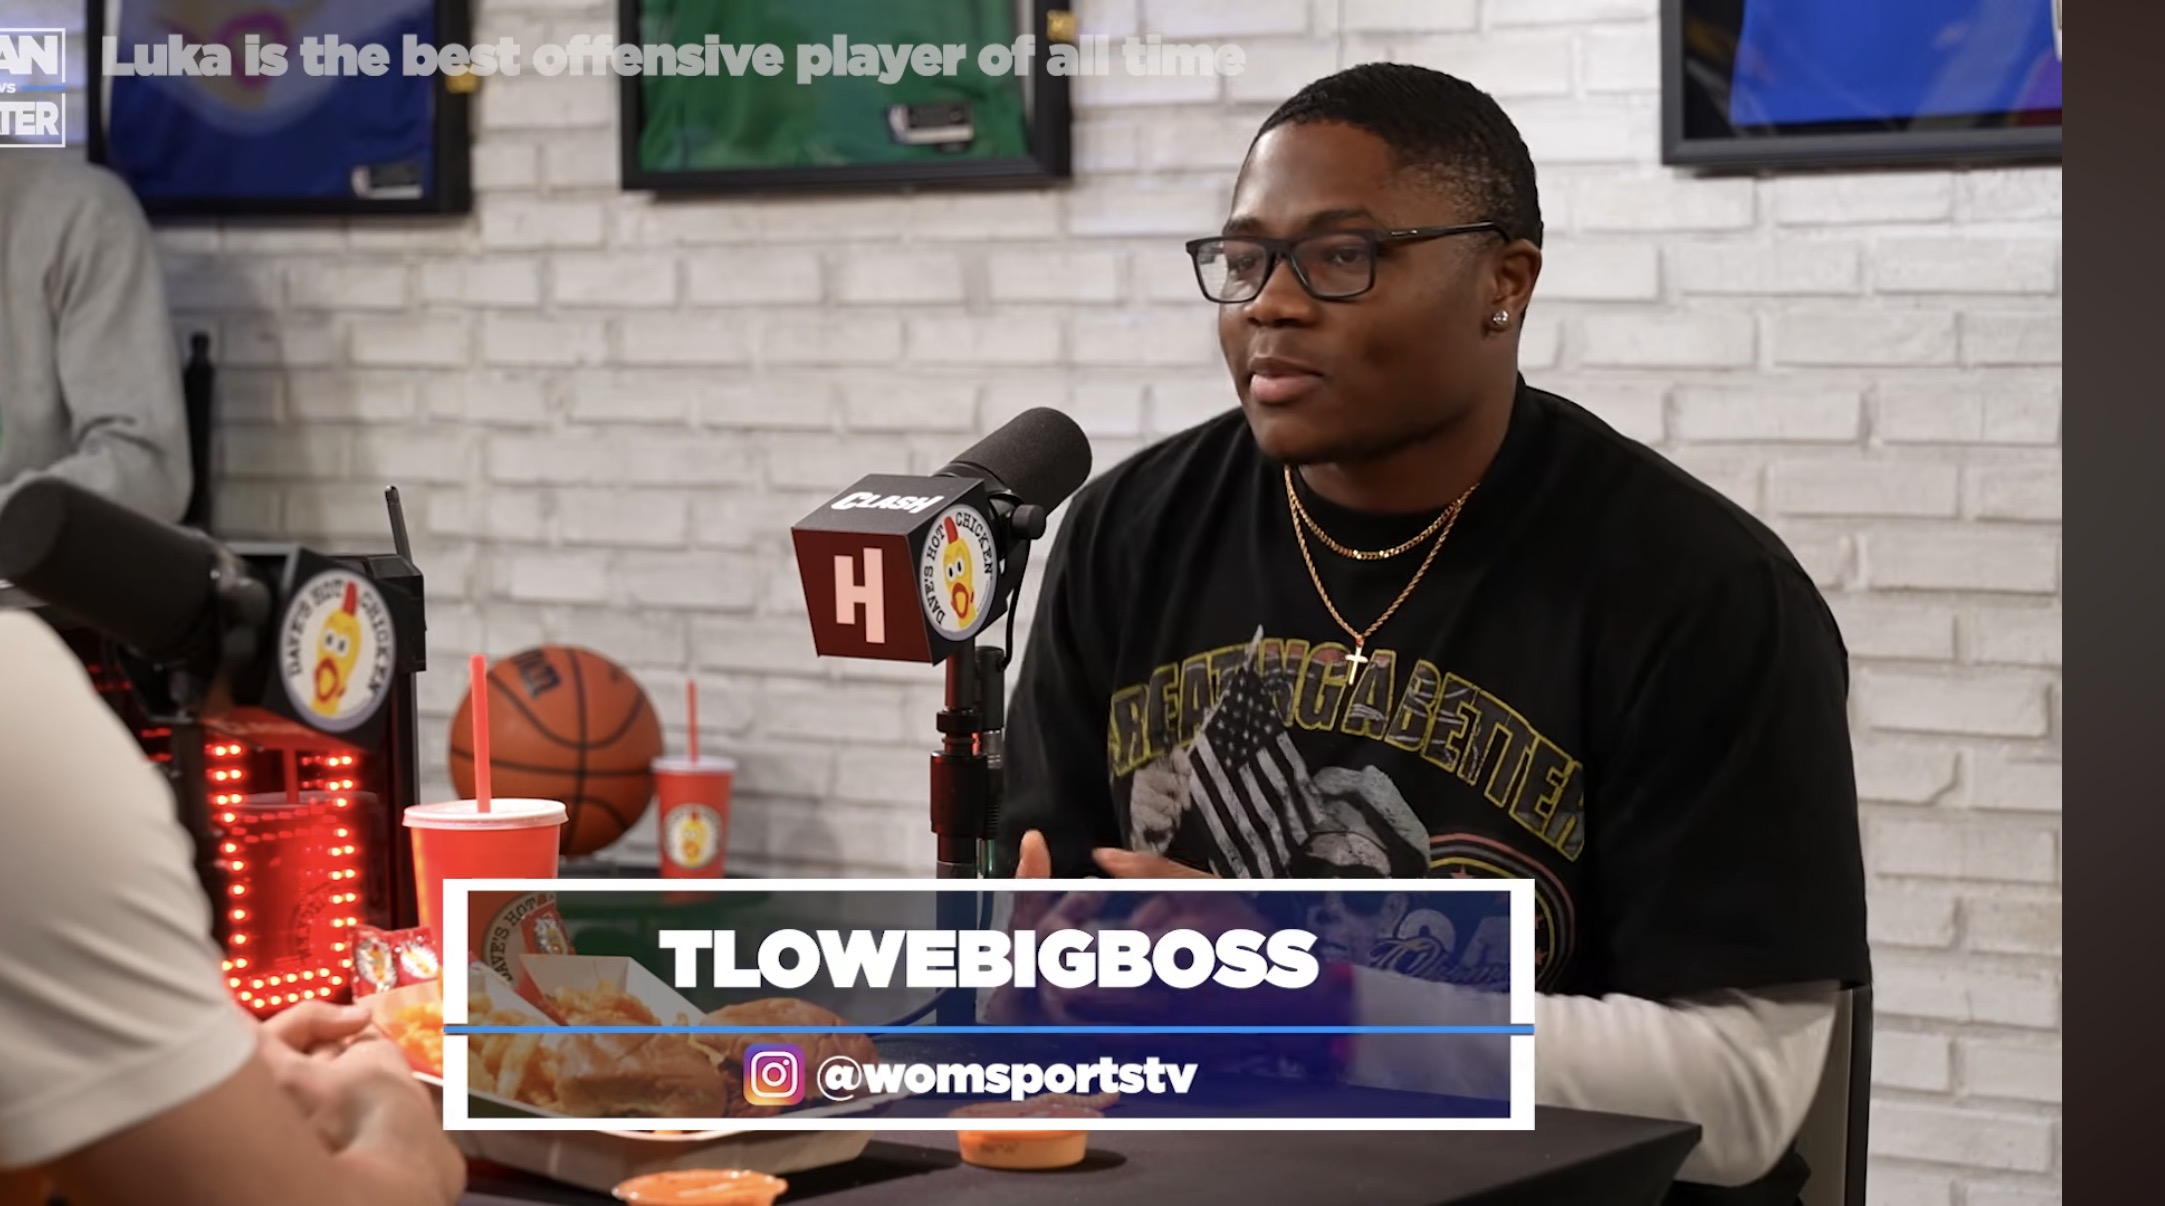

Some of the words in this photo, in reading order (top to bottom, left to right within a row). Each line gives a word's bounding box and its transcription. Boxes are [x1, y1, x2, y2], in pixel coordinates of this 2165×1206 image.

[831, 491, 944, 514] CLASH
[926, 524, 946, 561] HOT
[955, 511, 993, 575] CHICKEN
[834, 547, 885, 644] H
[924, 565, 946, 625] DAVE'S
